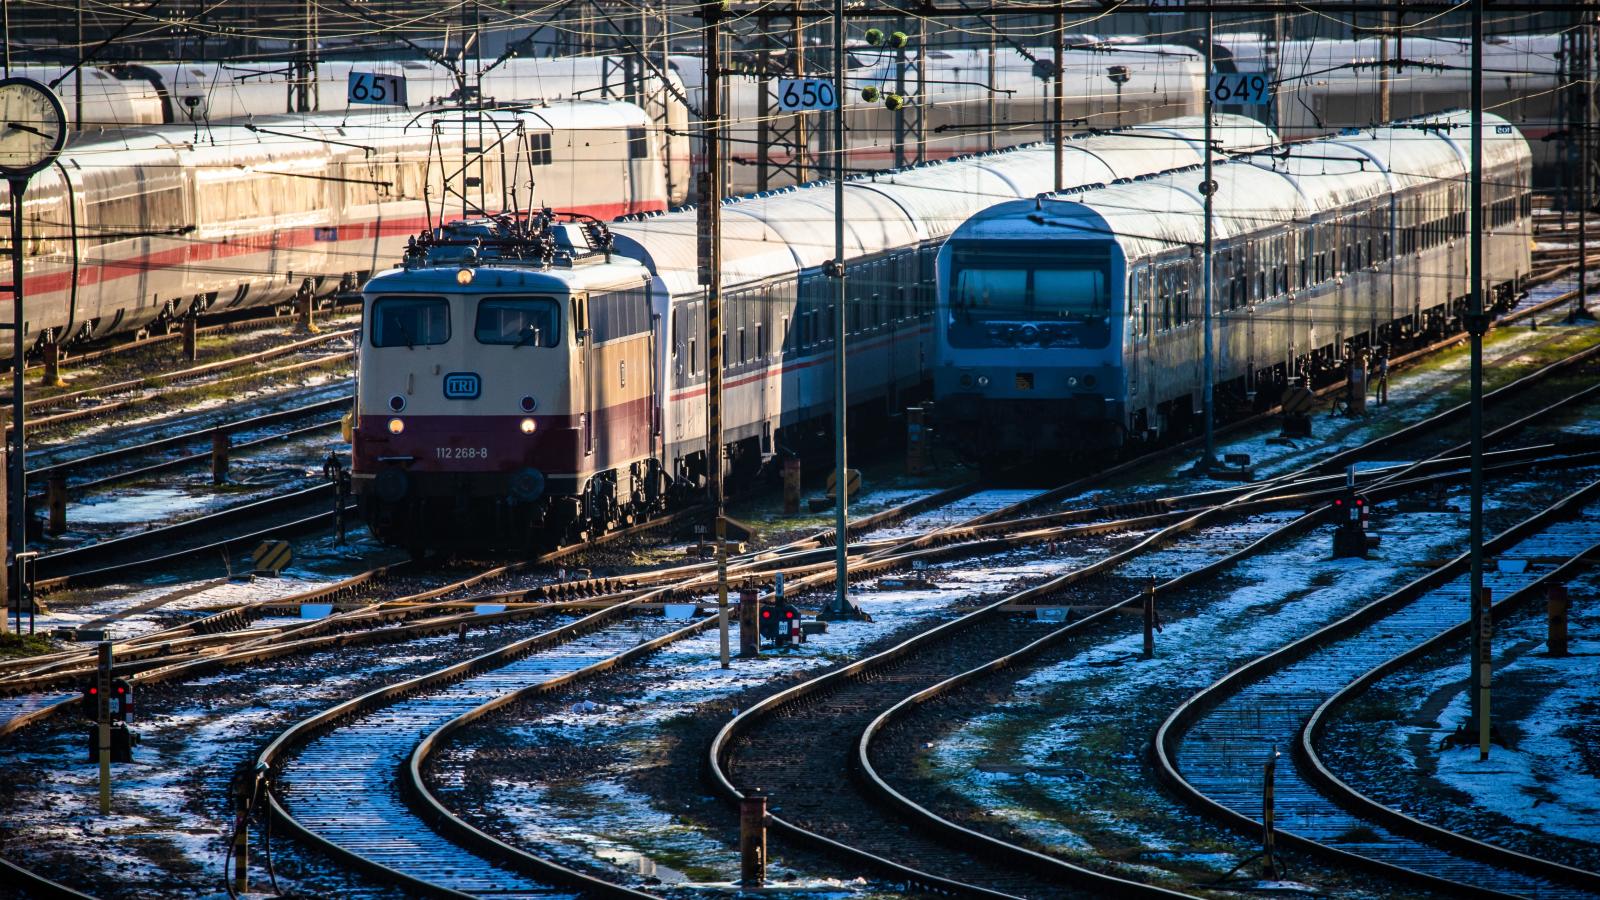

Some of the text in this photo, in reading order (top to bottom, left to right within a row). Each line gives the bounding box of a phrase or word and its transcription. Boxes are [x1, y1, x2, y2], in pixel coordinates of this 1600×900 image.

[352, 75, 398, 103] 651
[784, 81, 834, 107] 650
[1215, 76, 1265, 101] 649
[451, 380, 474, 392] TRI
[437, 447, 488, 459] 112 268-8
